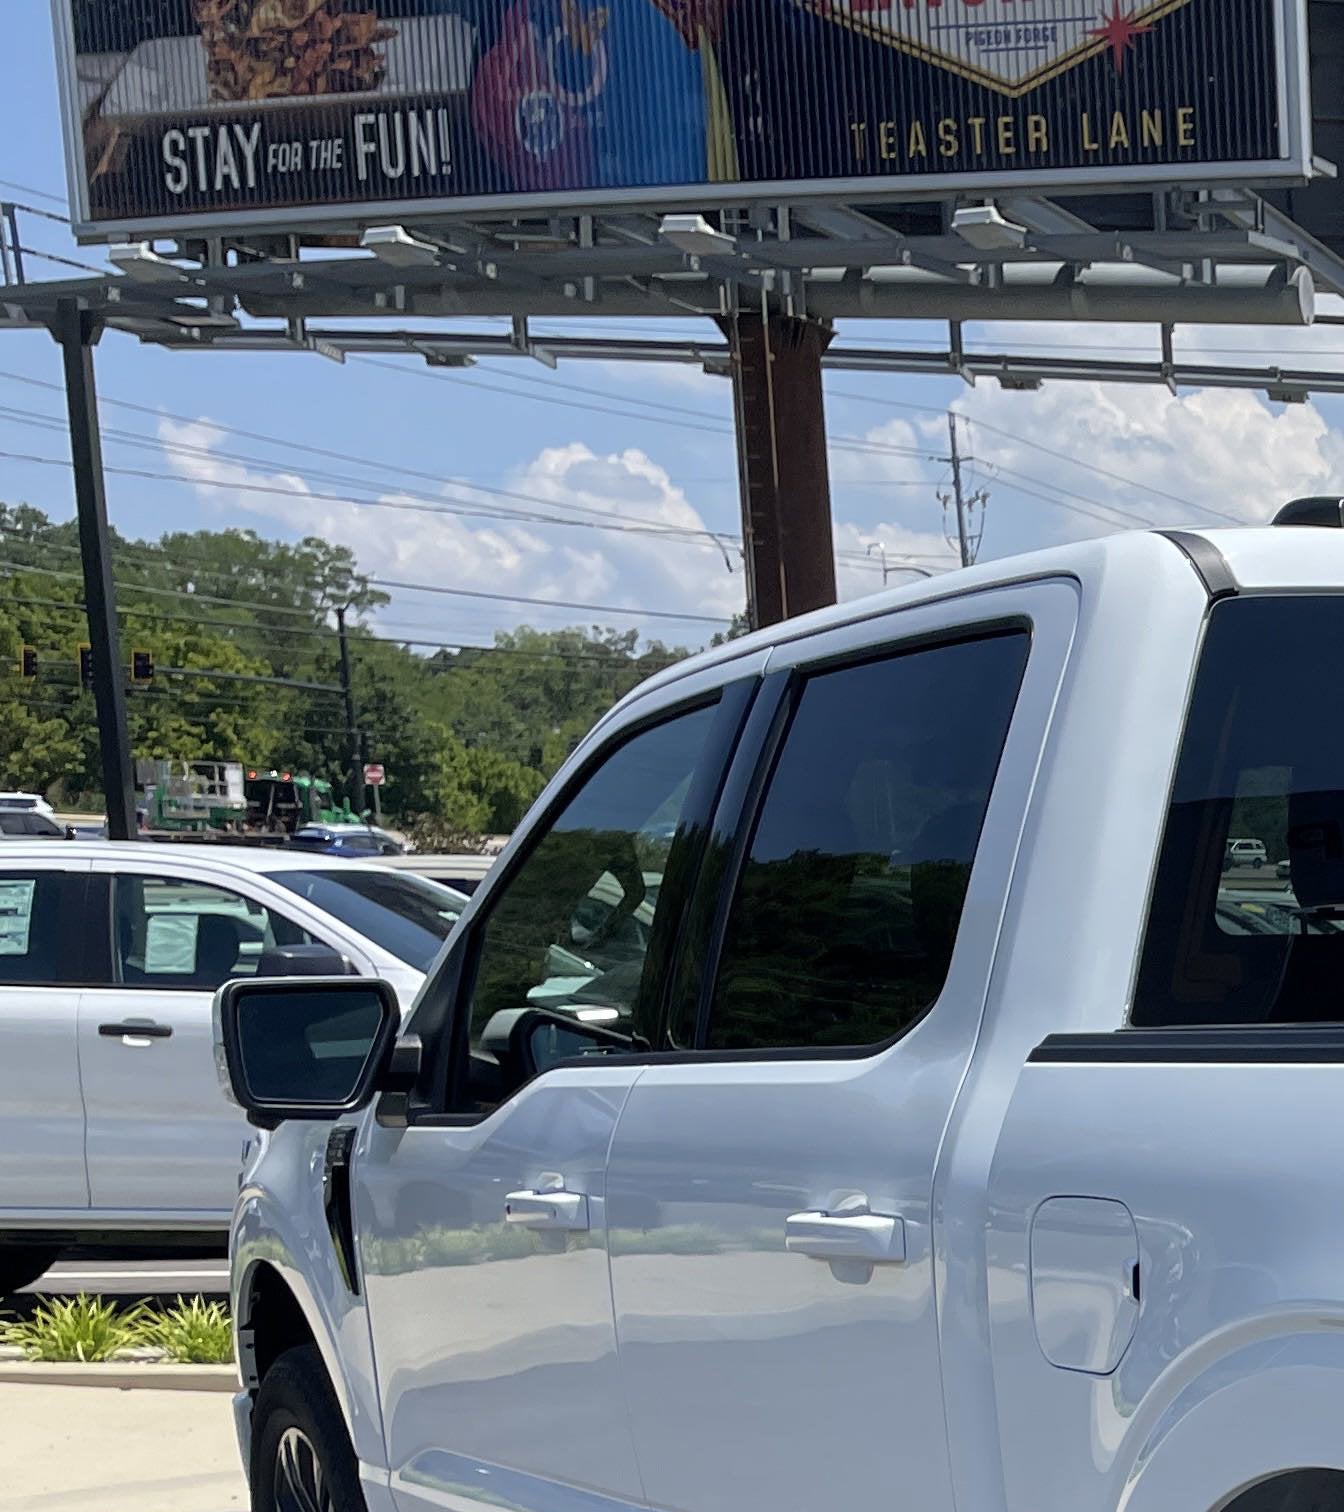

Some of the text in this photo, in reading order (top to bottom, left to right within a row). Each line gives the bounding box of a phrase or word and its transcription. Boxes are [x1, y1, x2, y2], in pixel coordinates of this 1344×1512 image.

[965, 26, 1057, 46] PIGEON FORGE
[162, 103, 451, 194] STAY FOR THE FUN!
[850, 107, 1196, 160] TEASTER LANE
